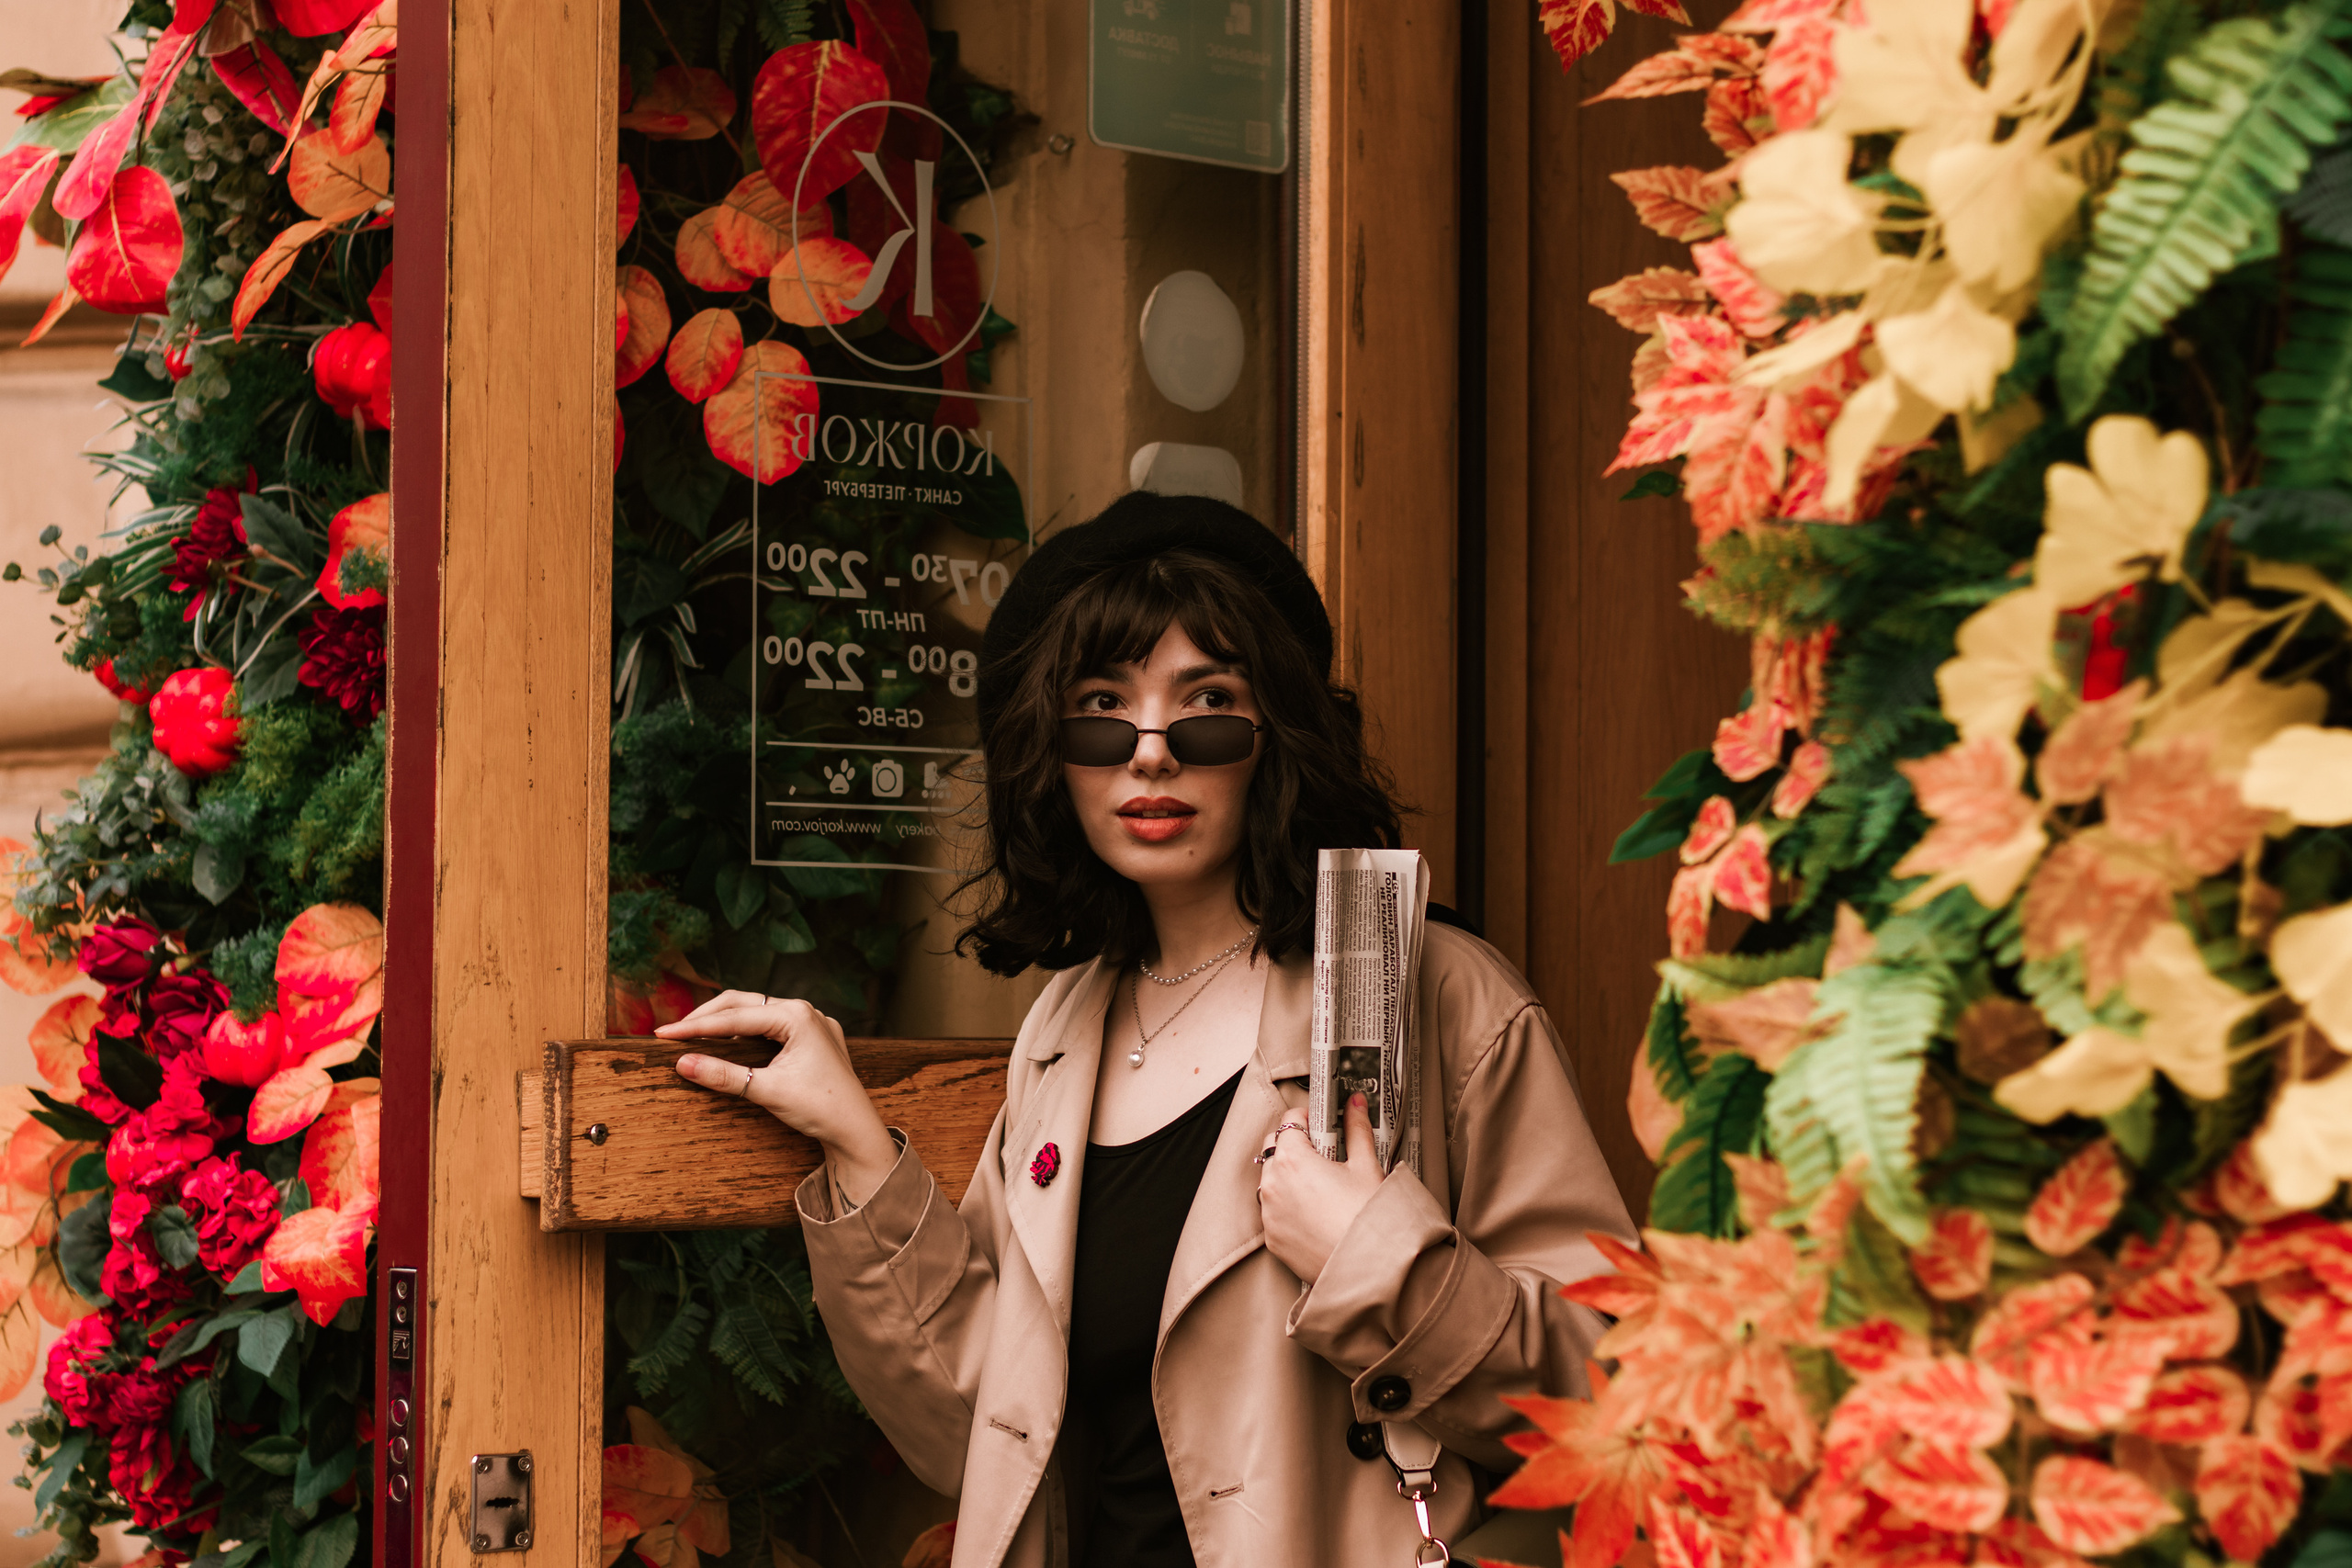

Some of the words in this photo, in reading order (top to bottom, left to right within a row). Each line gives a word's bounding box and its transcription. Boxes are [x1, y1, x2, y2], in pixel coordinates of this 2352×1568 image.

[1380, 886, 1386, 900] НЕ
[1385, 872, 1394, 925] ГОЛОВИН
[1381, 903, 1389, 976] РЕАЛИЗОВАЛ
[1388, 928, 1396, 993] ЗАРАБОТАЛ
[1384, 979, 1390, 995] НИ
